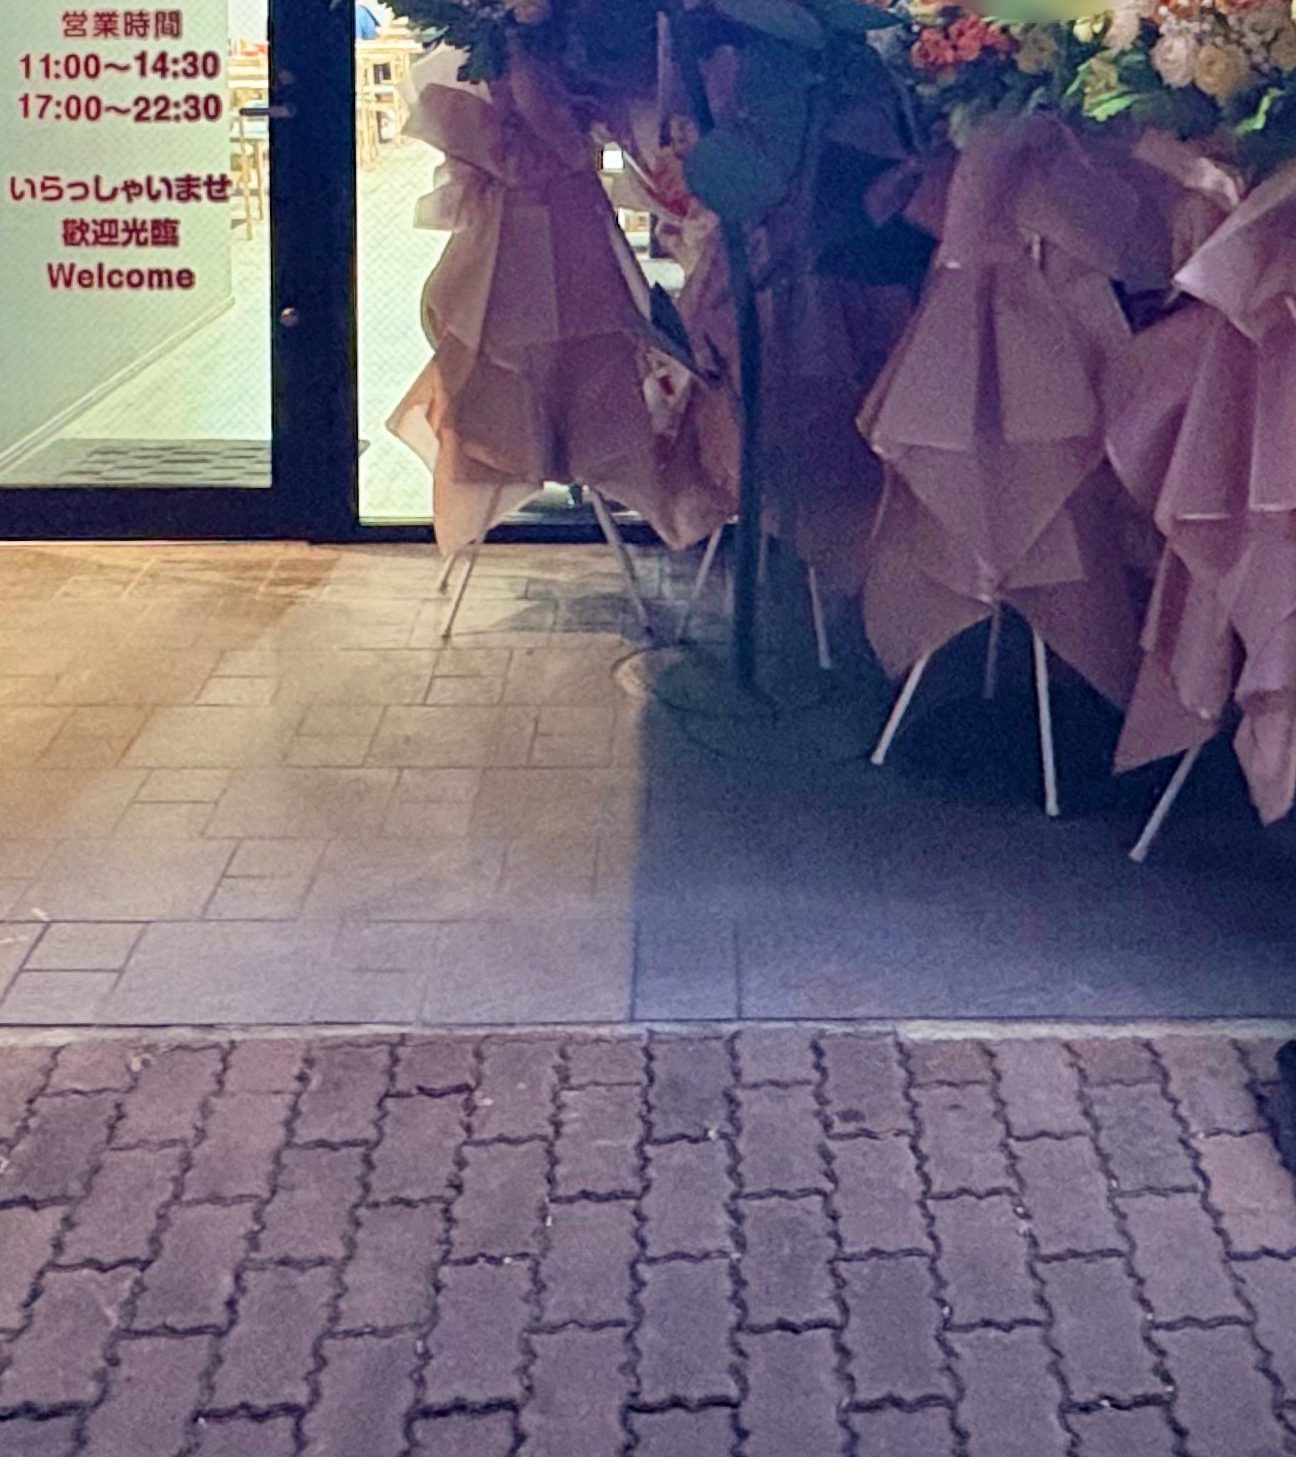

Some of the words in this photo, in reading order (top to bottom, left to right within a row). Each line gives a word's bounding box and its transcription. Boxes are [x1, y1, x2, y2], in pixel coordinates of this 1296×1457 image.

[61, 9, 183, 40] 営業時間
[9, 174, 233, 204] いらっしゃいませ
[47, 261, 196, 291] Welcome
